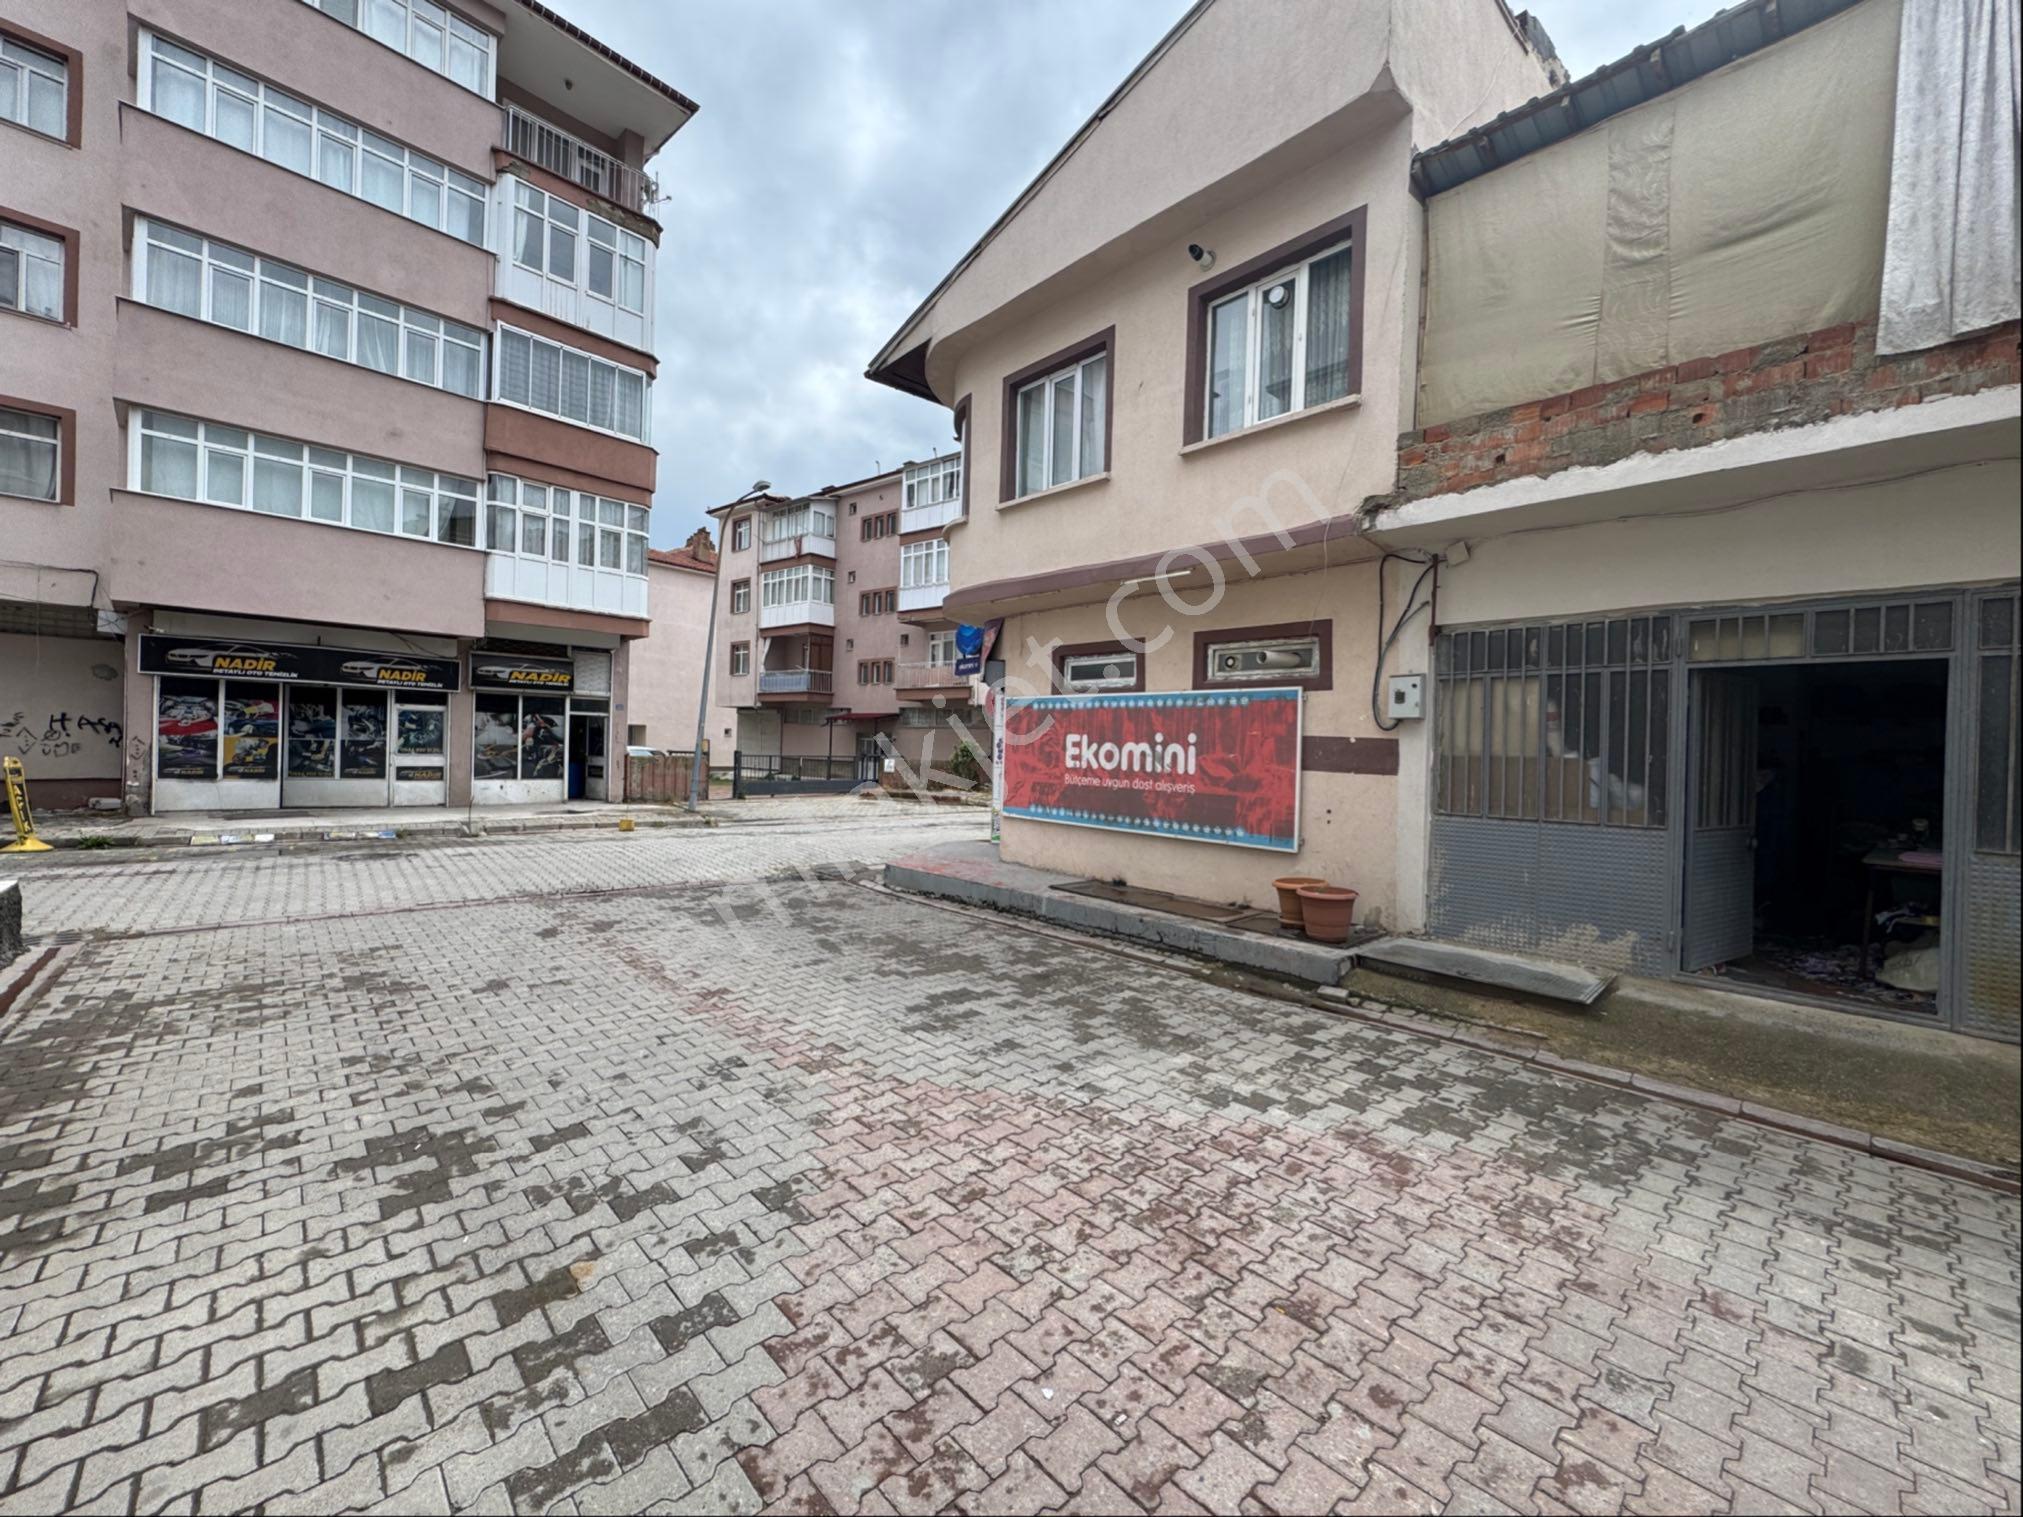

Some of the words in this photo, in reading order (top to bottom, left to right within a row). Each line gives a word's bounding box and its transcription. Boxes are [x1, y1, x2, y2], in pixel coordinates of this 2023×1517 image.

[214, 656, 277, 671] NADİR
[378, 668, 427, 682] NADİR
[511, 671, 572, 684] NADİR
[1065, 732, 1197, 775] Ekomini
[1102, 778, 1130, 790] uygun
[1132, 778, 1154, 791] dost
